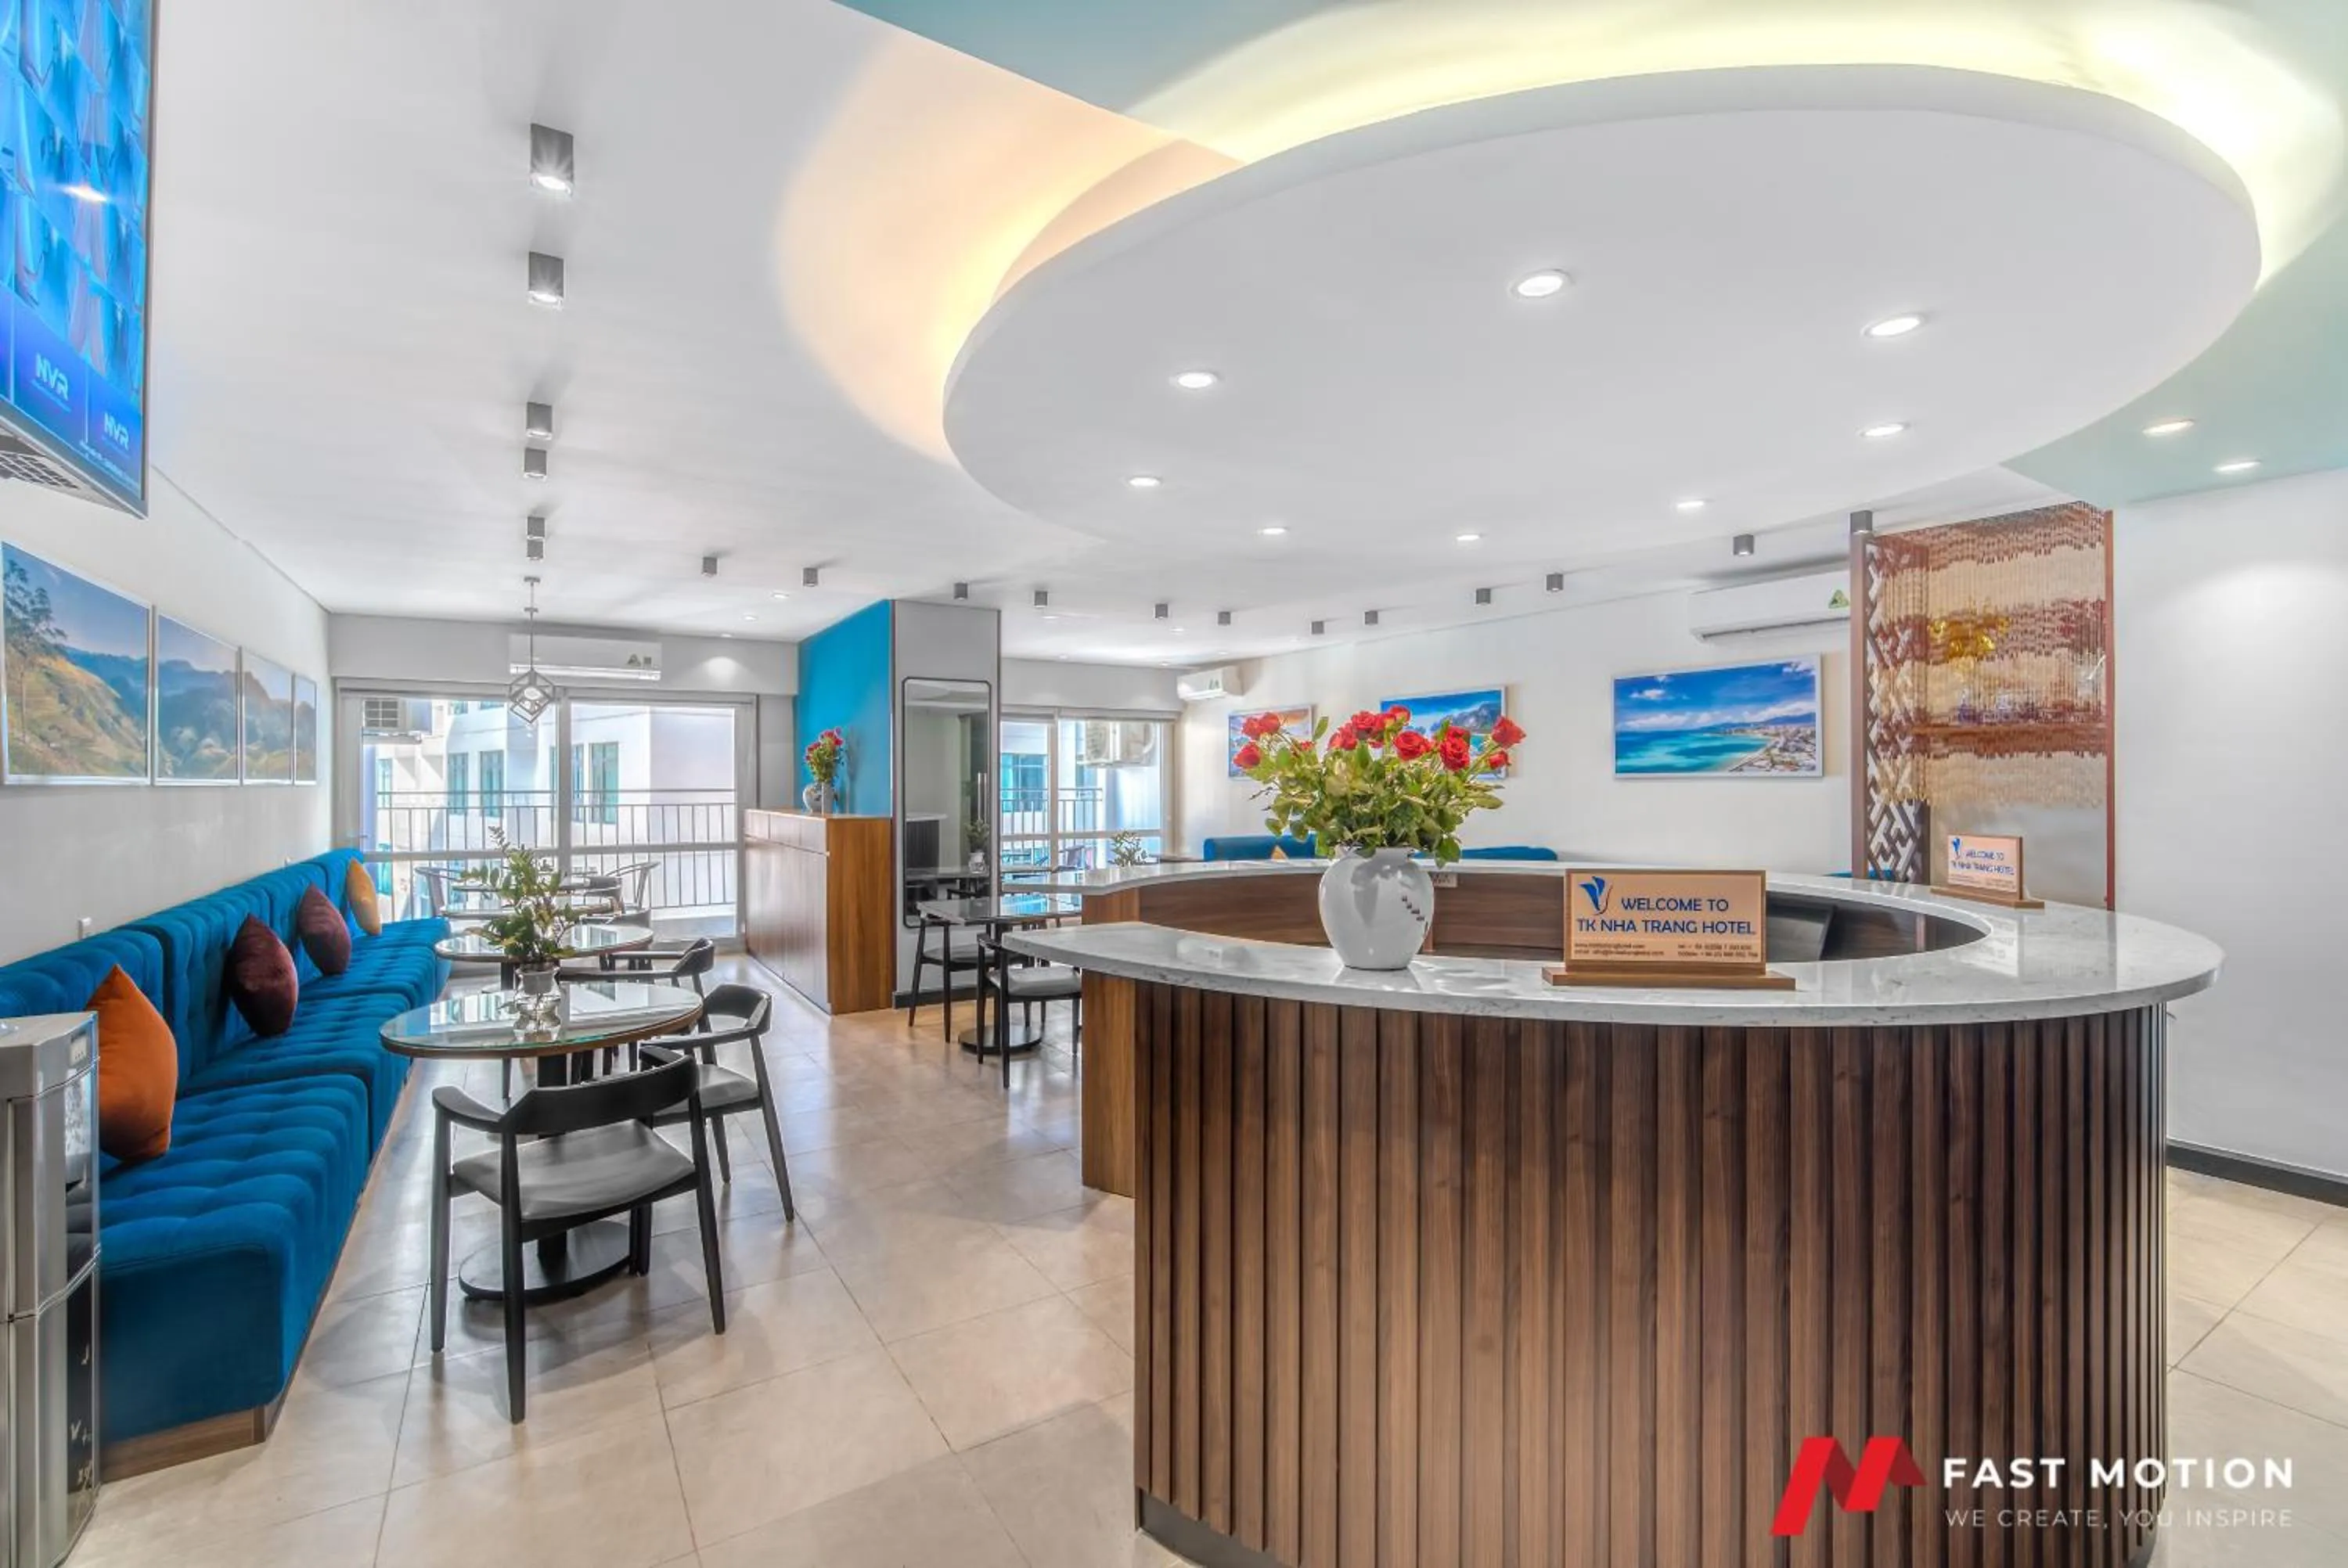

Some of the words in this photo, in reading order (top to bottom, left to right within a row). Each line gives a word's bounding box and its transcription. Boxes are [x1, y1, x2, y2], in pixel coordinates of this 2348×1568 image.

[36, 352, 69, 401] NVR
[104, 412, 129, 451] NVR
[1621, 897, 1702, 912] WELCOME
[1707, 899, 1729, 912] TO
[1577, 918, 1597, 932] TK
[1601, 919, 1637, 932] NHA
[1642, 919, 1698, 933] TRANG
[1702, 921, 1756, 934] HOTEL
